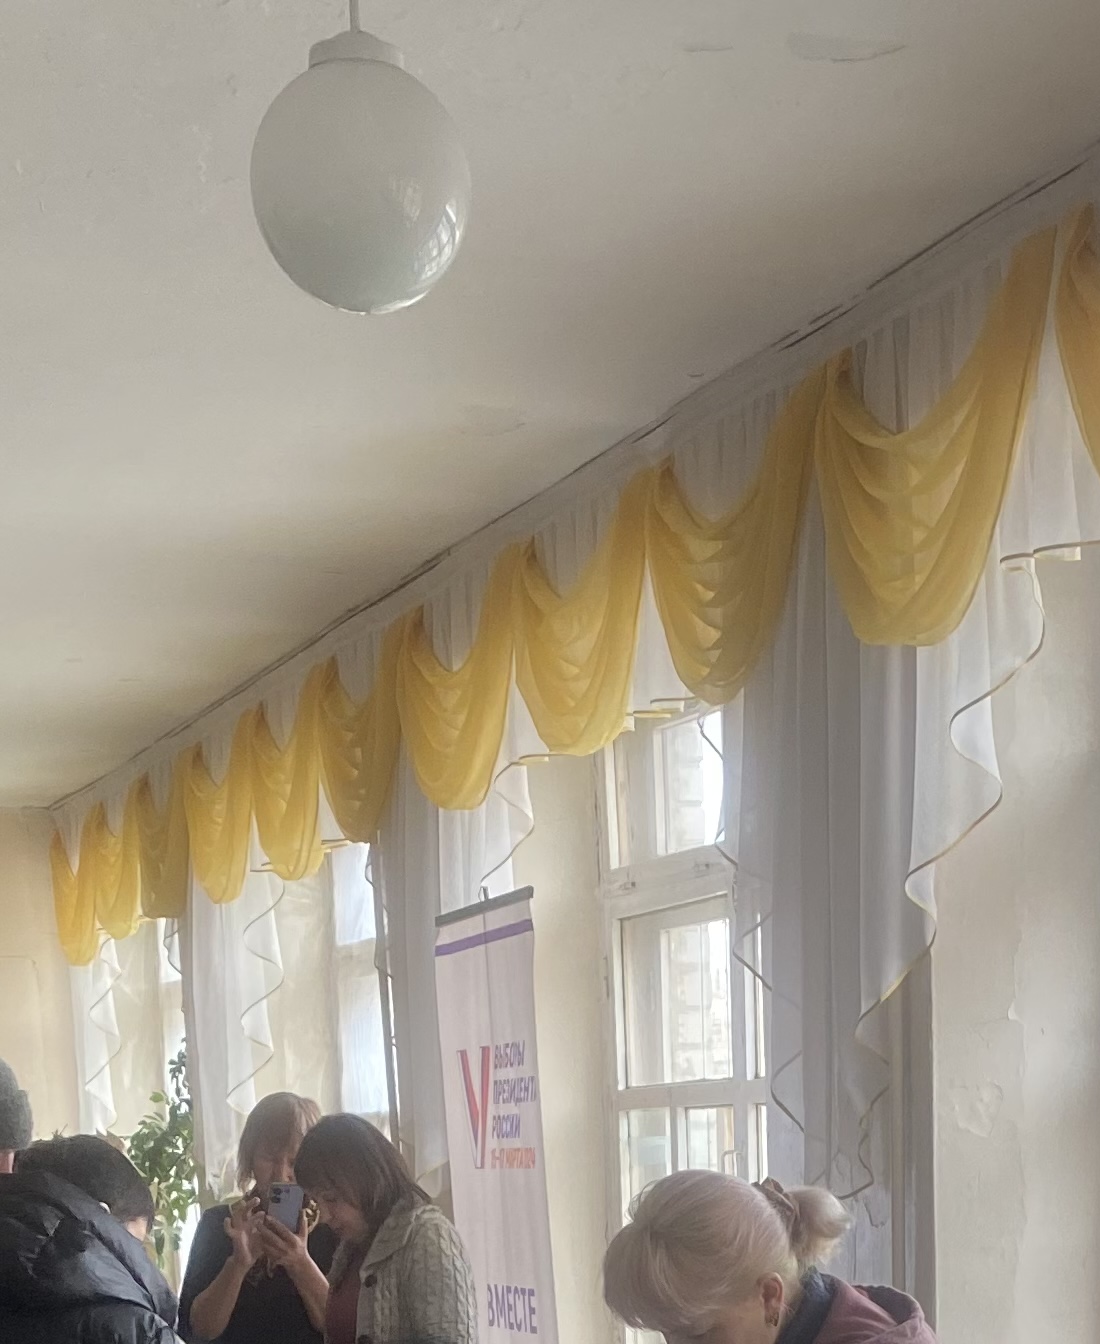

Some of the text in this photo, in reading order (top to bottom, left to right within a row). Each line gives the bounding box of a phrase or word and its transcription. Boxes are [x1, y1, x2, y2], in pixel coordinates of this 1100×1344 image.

[494, 1040, 525, 1069] ВЫБОРЫ
[491, 1114, 521, 1140] РОССИИ
[486, 1283, 538, 1335] ВМЕСТЕ
